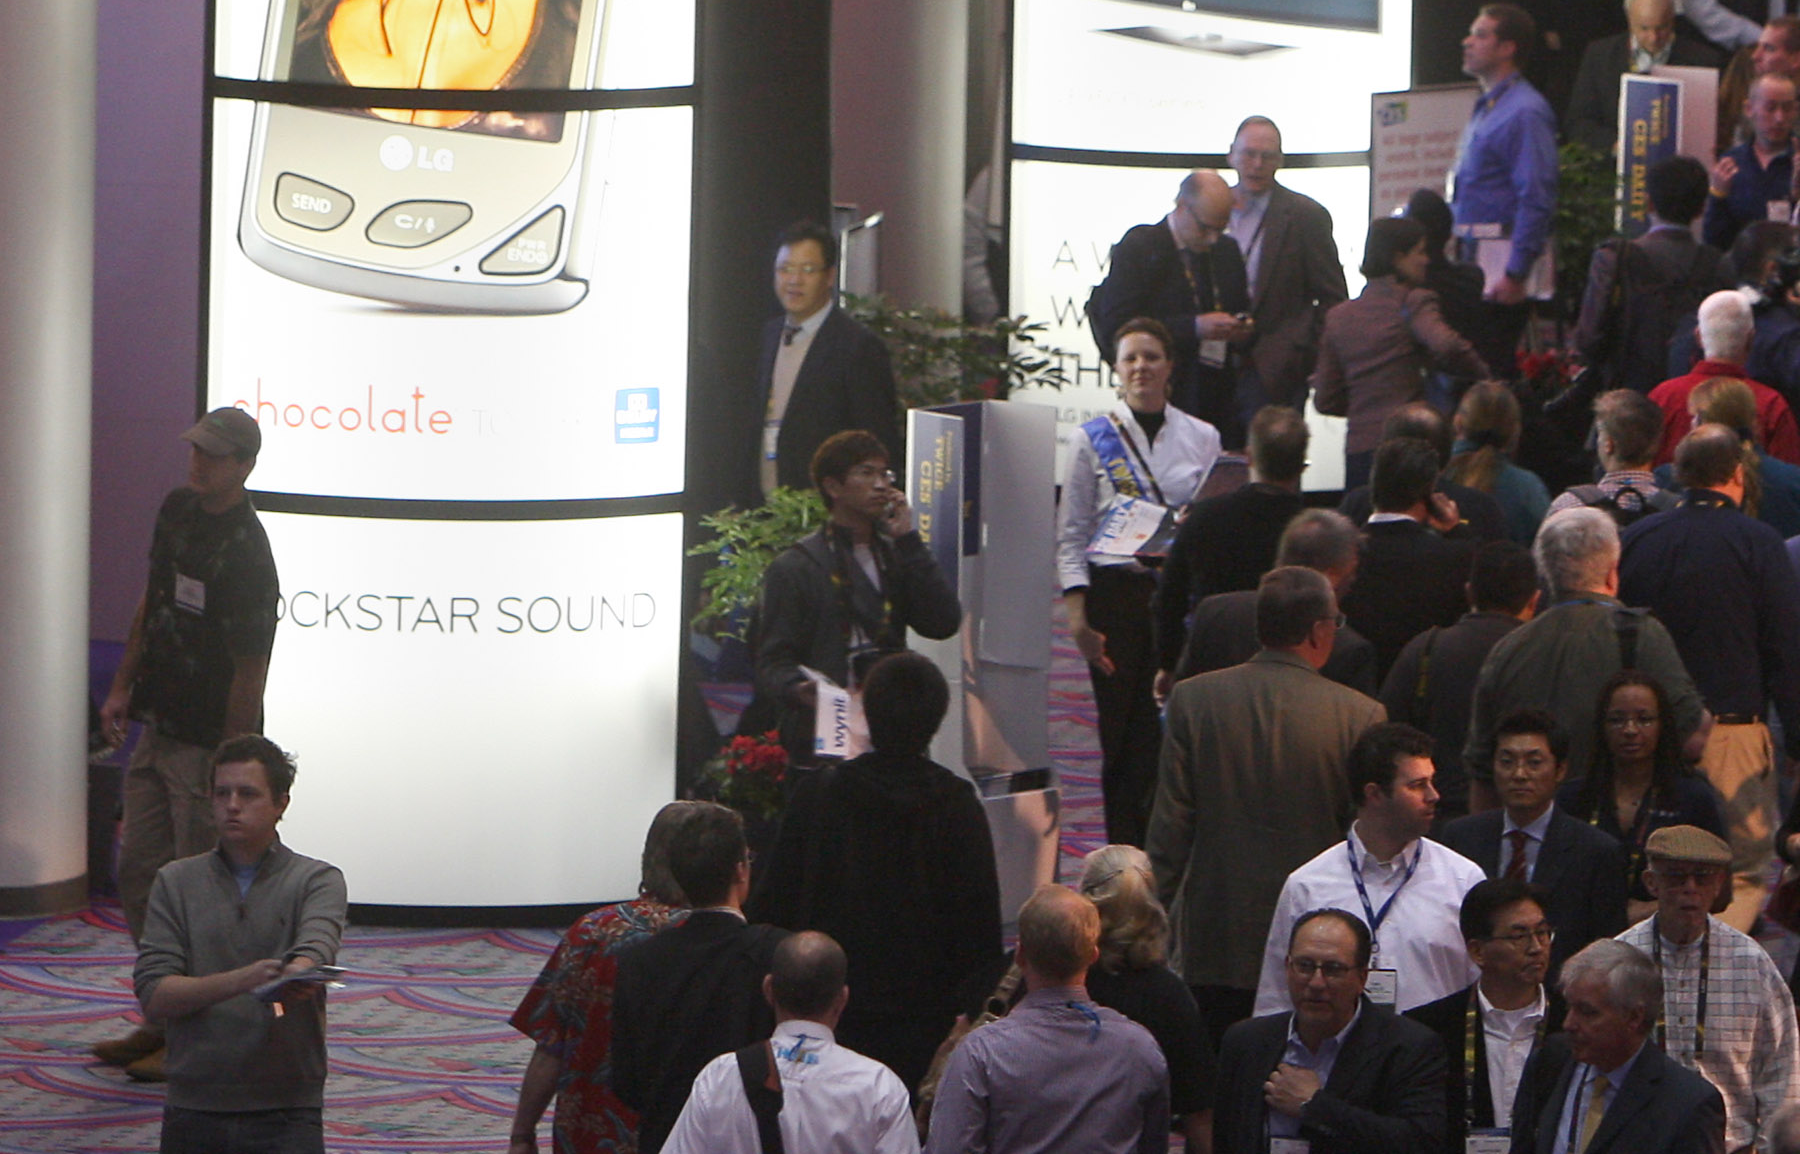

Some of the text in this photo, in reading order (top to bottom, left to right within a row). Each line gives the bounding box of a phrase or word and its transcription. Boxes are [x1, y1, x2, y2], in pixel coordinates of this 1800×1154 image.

[417, 146, 455, 171] LG
[291, 193, 332, 214] SEND
[232, 378, 453, 434] hocolate
[919, 460, 933, 505] CES
[934, 436, 945, 491] TWICE
[497, 592, 657, 634] SOUND
